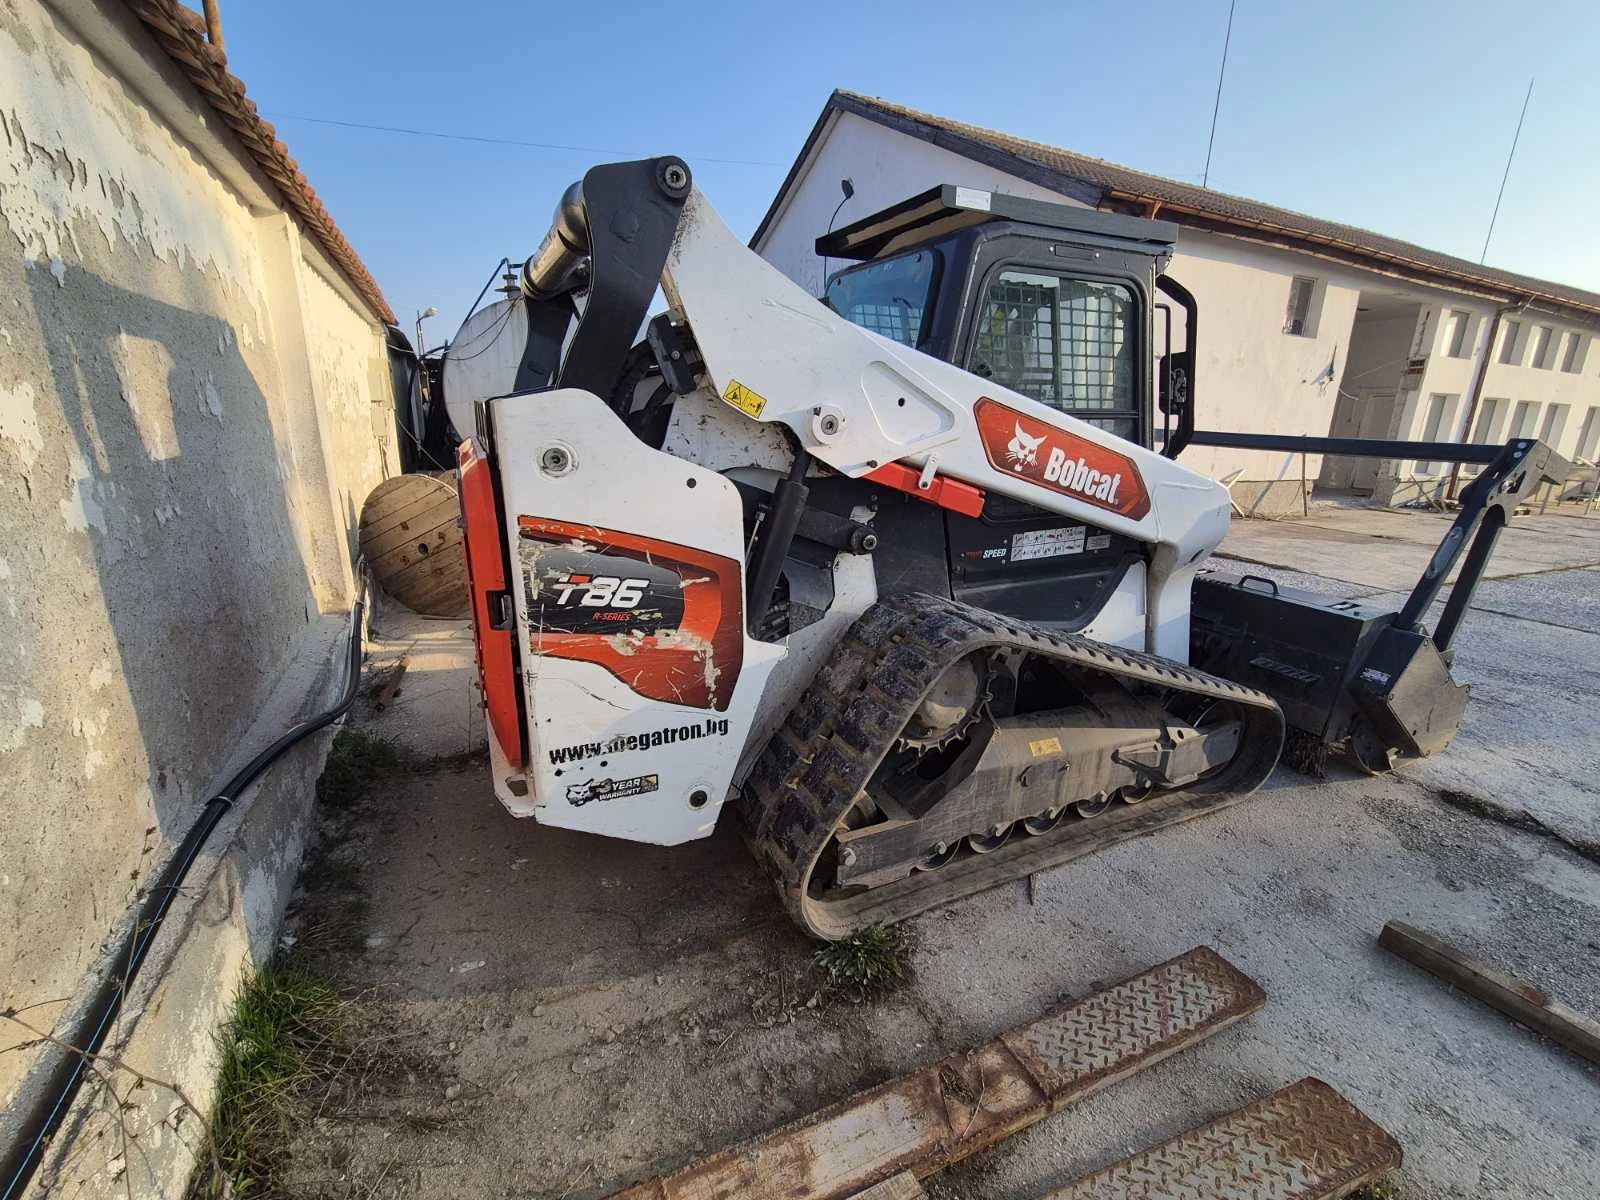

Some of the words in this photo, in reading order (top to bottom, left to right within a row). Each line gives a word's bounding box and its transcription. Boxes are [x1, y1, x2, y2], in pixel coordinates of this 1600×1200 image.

[1044, 447, 1121, 504] Bobcat
[983, 548, 1007, 559] SPEED
[556, 574, 650, 608] T86
[593, 611, 631, 622] R-SERIES
[611, 779, 641, 791] YEAR
